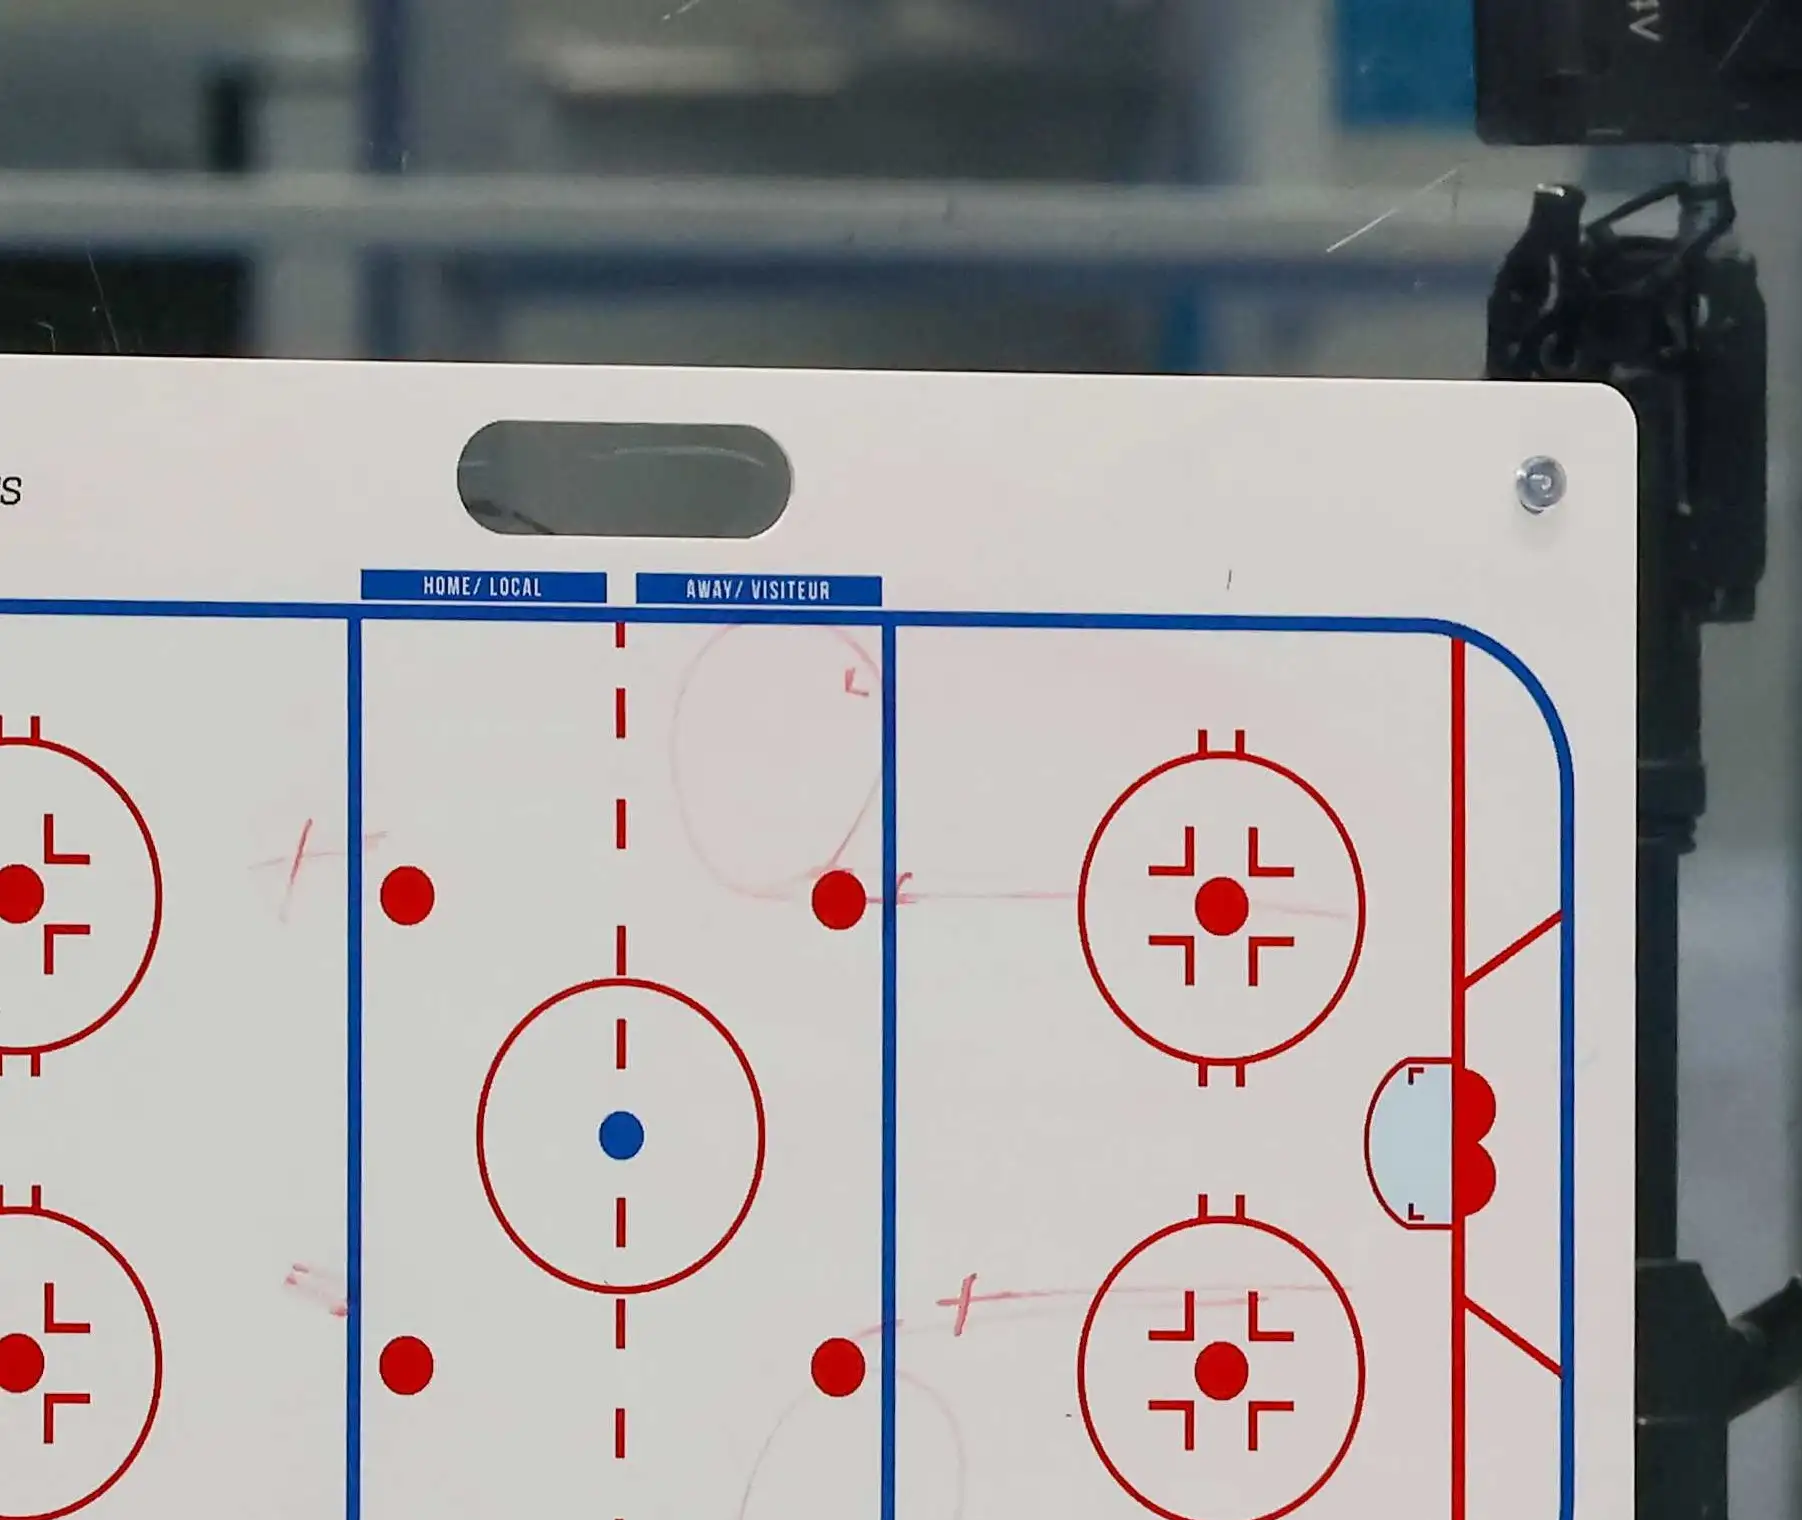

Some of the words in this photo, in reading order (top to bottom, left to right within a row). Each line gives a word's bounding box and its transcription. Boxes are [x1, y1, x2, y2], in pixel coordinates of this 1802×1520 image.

[424, 576, 481, 595] HOME/
[490, 577, 541, 597] LOCAL
[686, 579, 743, 599] AWAY/
[752, 579, 829, 600] VISITEUR
